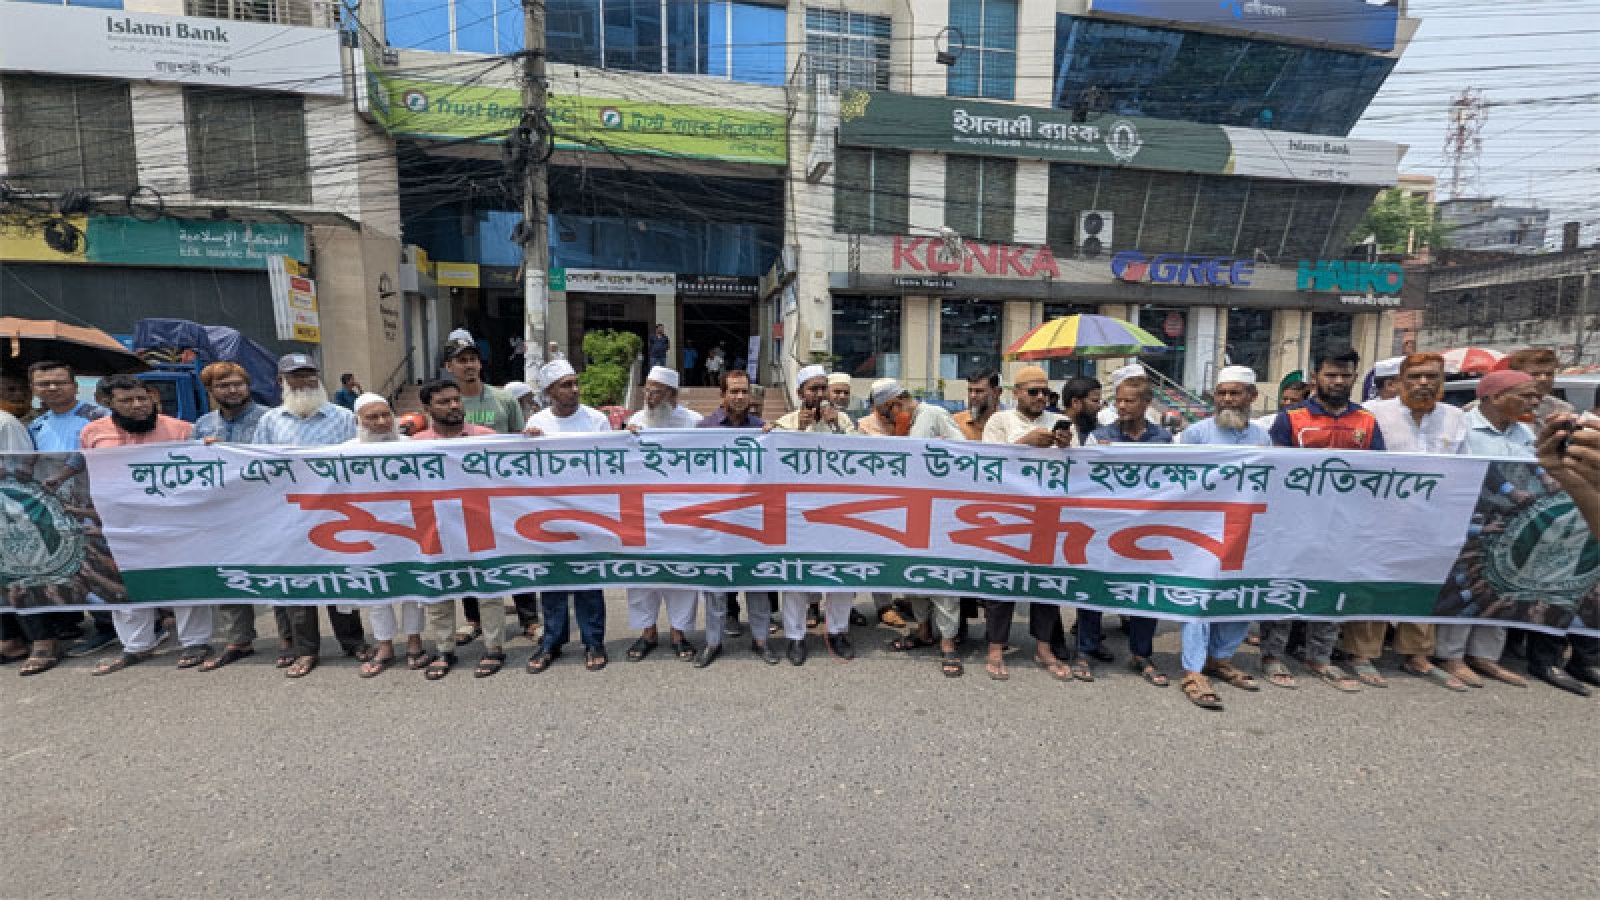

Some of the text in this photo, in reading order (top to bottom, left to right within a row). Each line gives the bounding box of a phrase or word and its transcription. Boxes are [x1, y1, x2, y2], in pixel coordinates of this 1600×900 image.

[106, 16, 171, 37] Islami
[175, 23, 230, 43] Bank
[435, 96, 483, 118] Trust
[952, 109, 1034, 138] ইসলামী
[1037, 121, 1101, 144] ব্যাংক
[1288, 139, 1350, 155] Islami Bank
[891, 234, 1063, 280] KONKA
[1150, 251, 1255, 287] GREE
[129, 436, 1443, 502] লুটেরা এস আলমের প্ররোচনায় ইসলামী ব্যাংকের উপর নগ্ন হস্তক্ষেপের প্রতিবাদে
[286, 481, 1267, 571] মানববন্ধন
[218, 566, 398, 596] ইসলামী
[416, 561, 553, 592] ব্যাংক
[566, 557, 744, 583] সচেতন
[750, 558, 884, 584] গ্রাহক
[902, 563, 1090, 602] ফোরাম,
[1106, 578, 1322, 613] রাজশাহী
